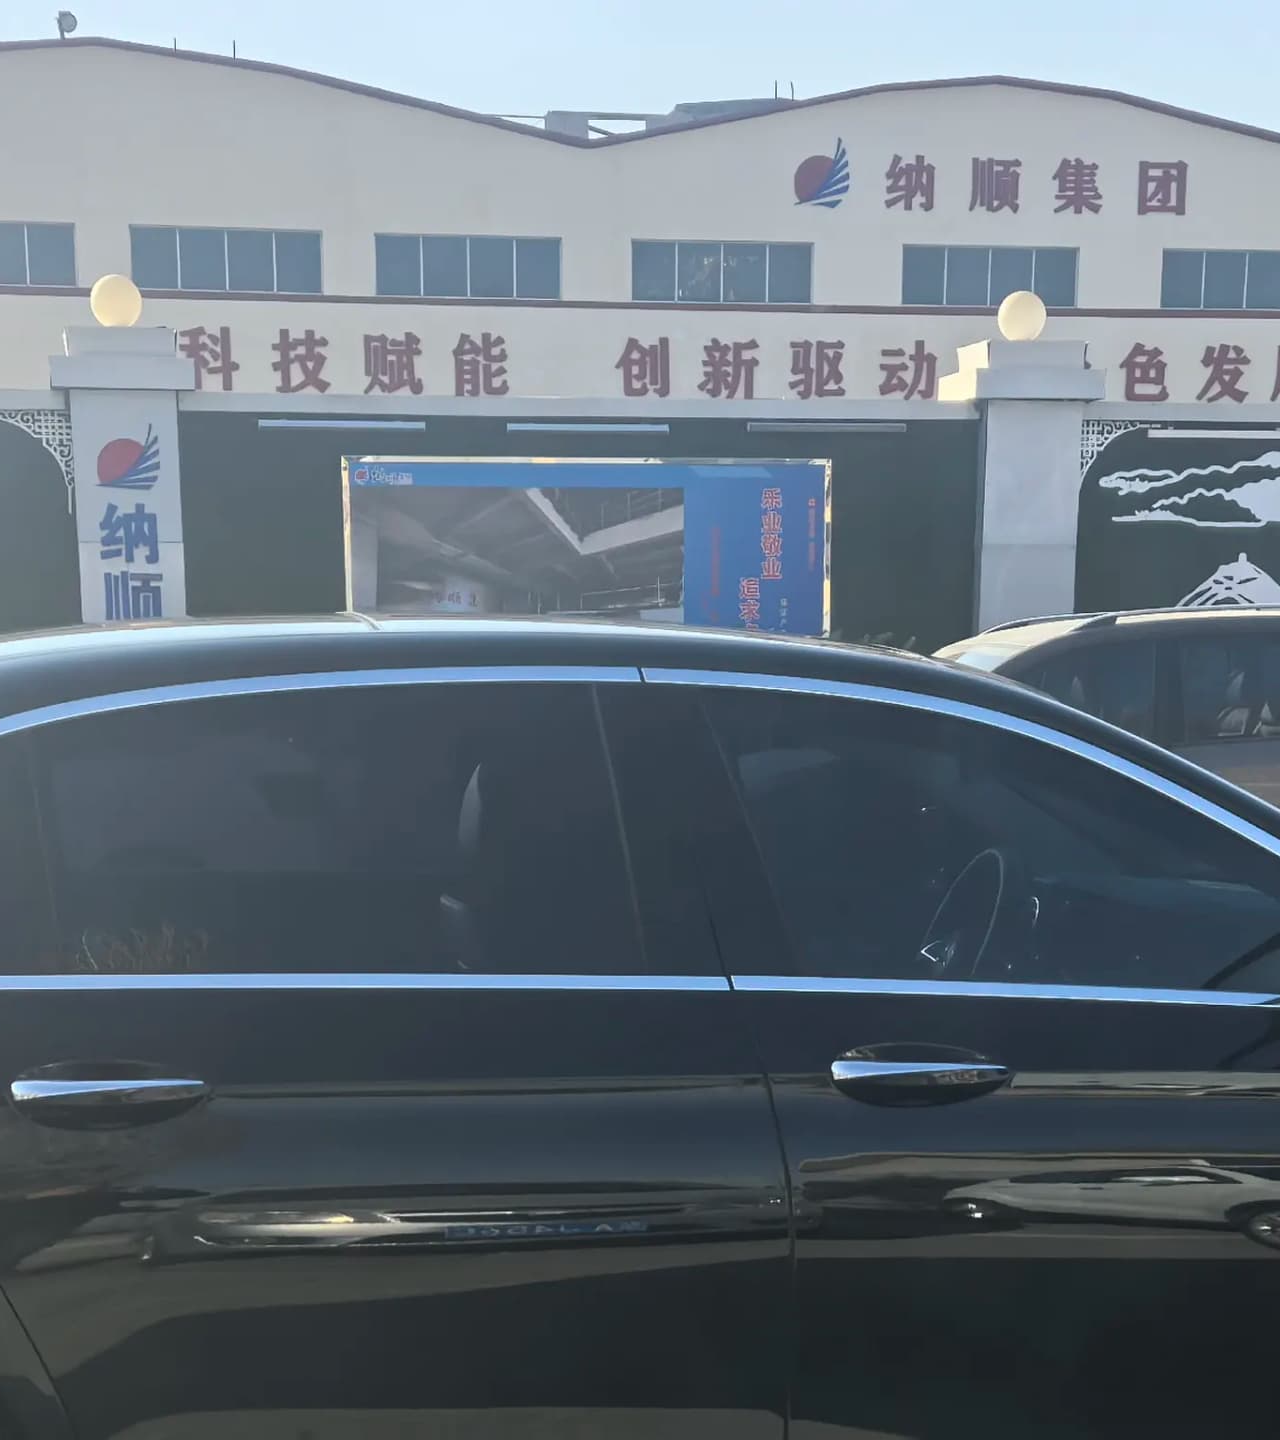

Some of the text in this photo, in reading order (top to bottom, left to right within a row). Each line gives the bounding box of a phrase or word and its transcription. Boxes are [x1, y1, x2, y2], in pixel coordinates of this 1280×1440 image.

[883, 153, 1189, 216] 纳顺集团
[178, 325, 510, 398] 科技赋能
[614, 336, 939, 401] 创新驱动
[99, 502, 164, 621] 纳顺
